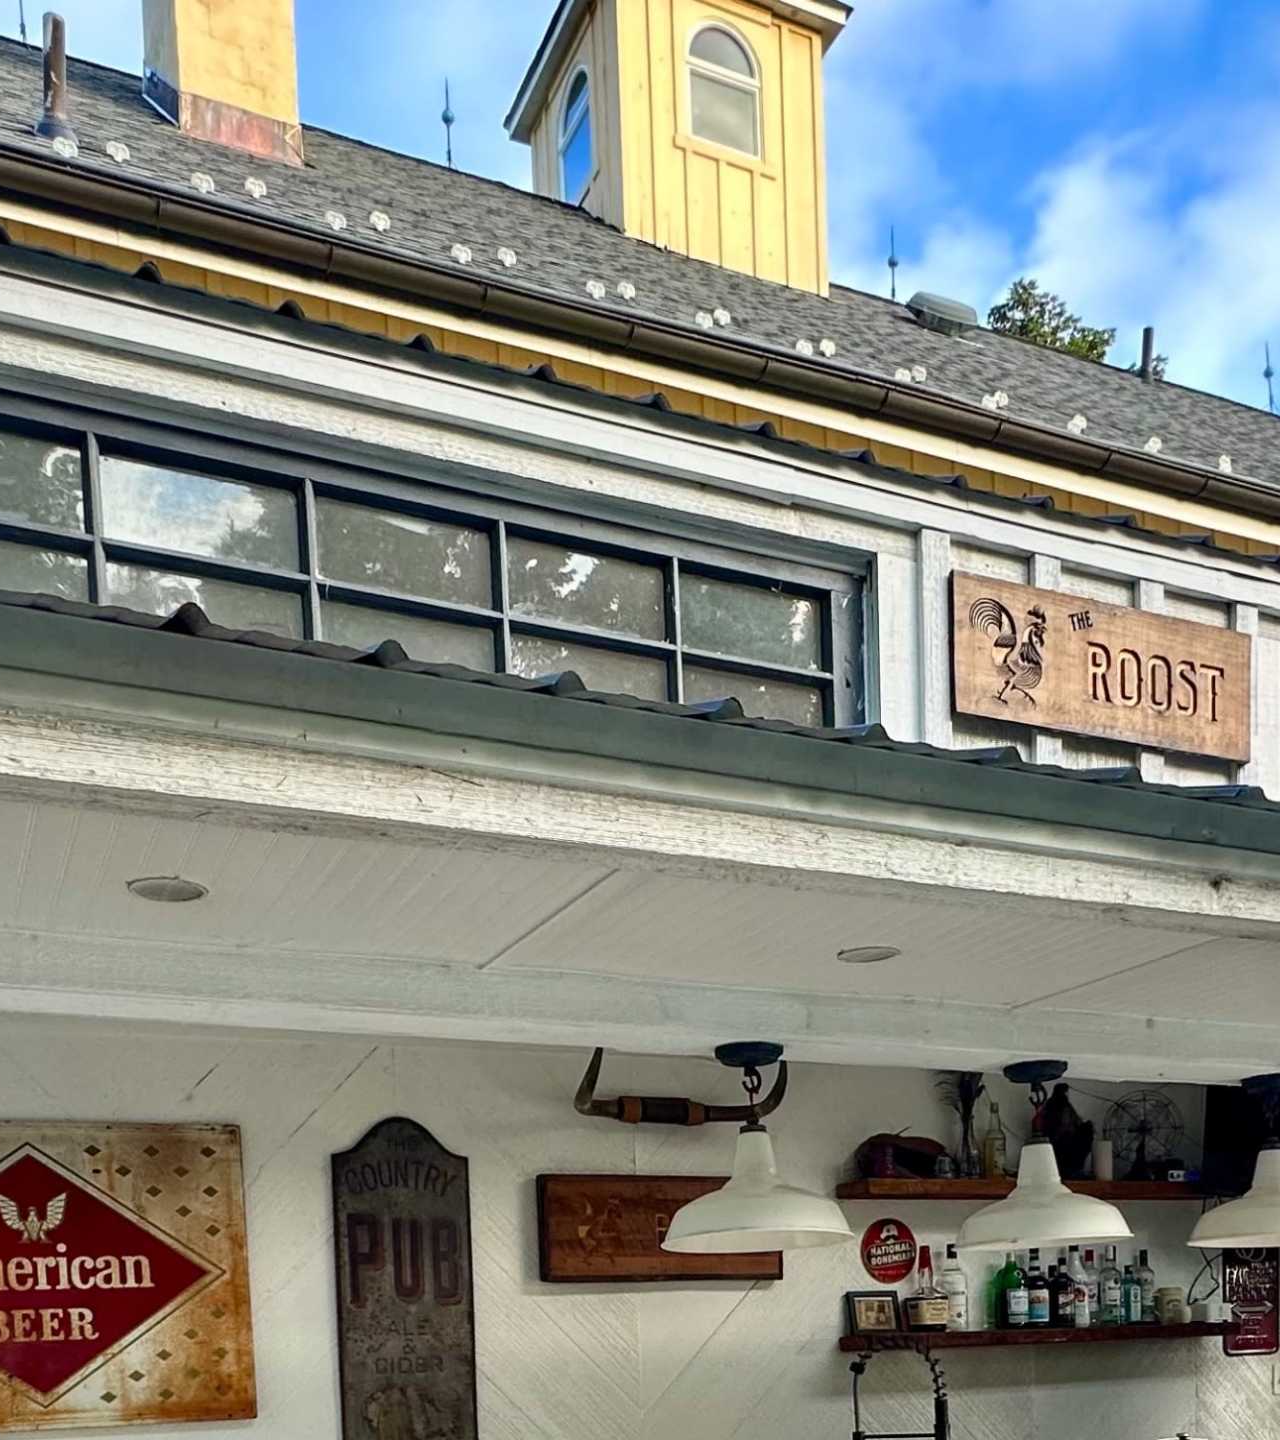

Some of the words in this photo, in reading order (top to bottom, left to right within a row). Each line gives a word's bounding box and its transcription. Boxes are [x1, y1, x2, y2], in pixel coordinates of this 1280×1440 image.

[1068, 610, 1094, 632] THE
[1086, 640, 1225, 723] ROOST
[344, 1159, 458, 1197] COUNTRY
[346, 1212, 464, 1308] PUB
[870, 1242, 911, 1255] NATIONAL
